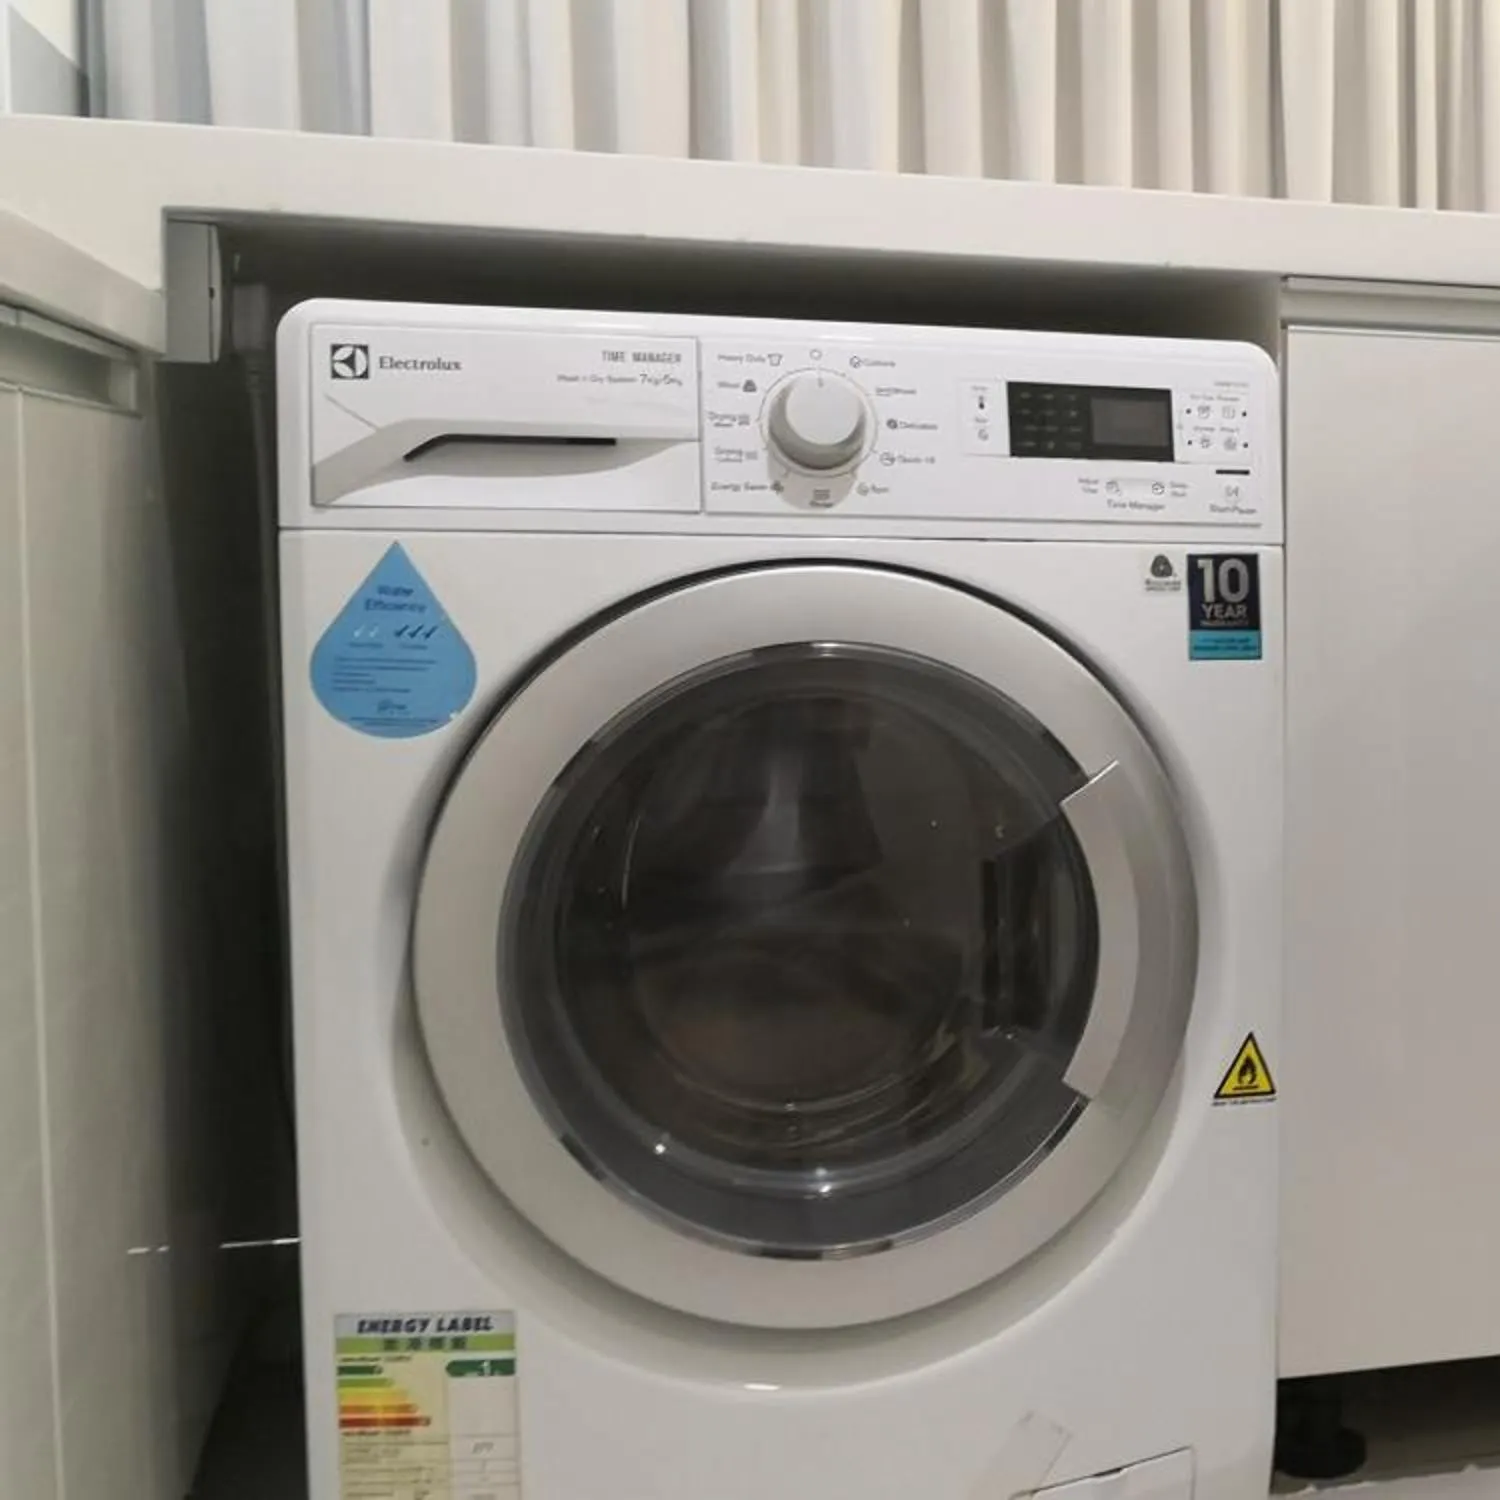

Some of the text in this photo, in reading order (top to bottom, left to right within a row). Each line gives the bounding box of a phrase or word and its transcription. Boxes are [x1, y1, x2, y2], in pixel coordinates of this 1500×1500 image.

[379, 355, 463, 371] Electrolux
[602, 350, 682, 364] TIME MANAGER
[1197, 558, 1249, 603] 10
[1201, 603, 1248, 620] YEAR
[357, 1316, 493, 1334] ENERGY LABEL
